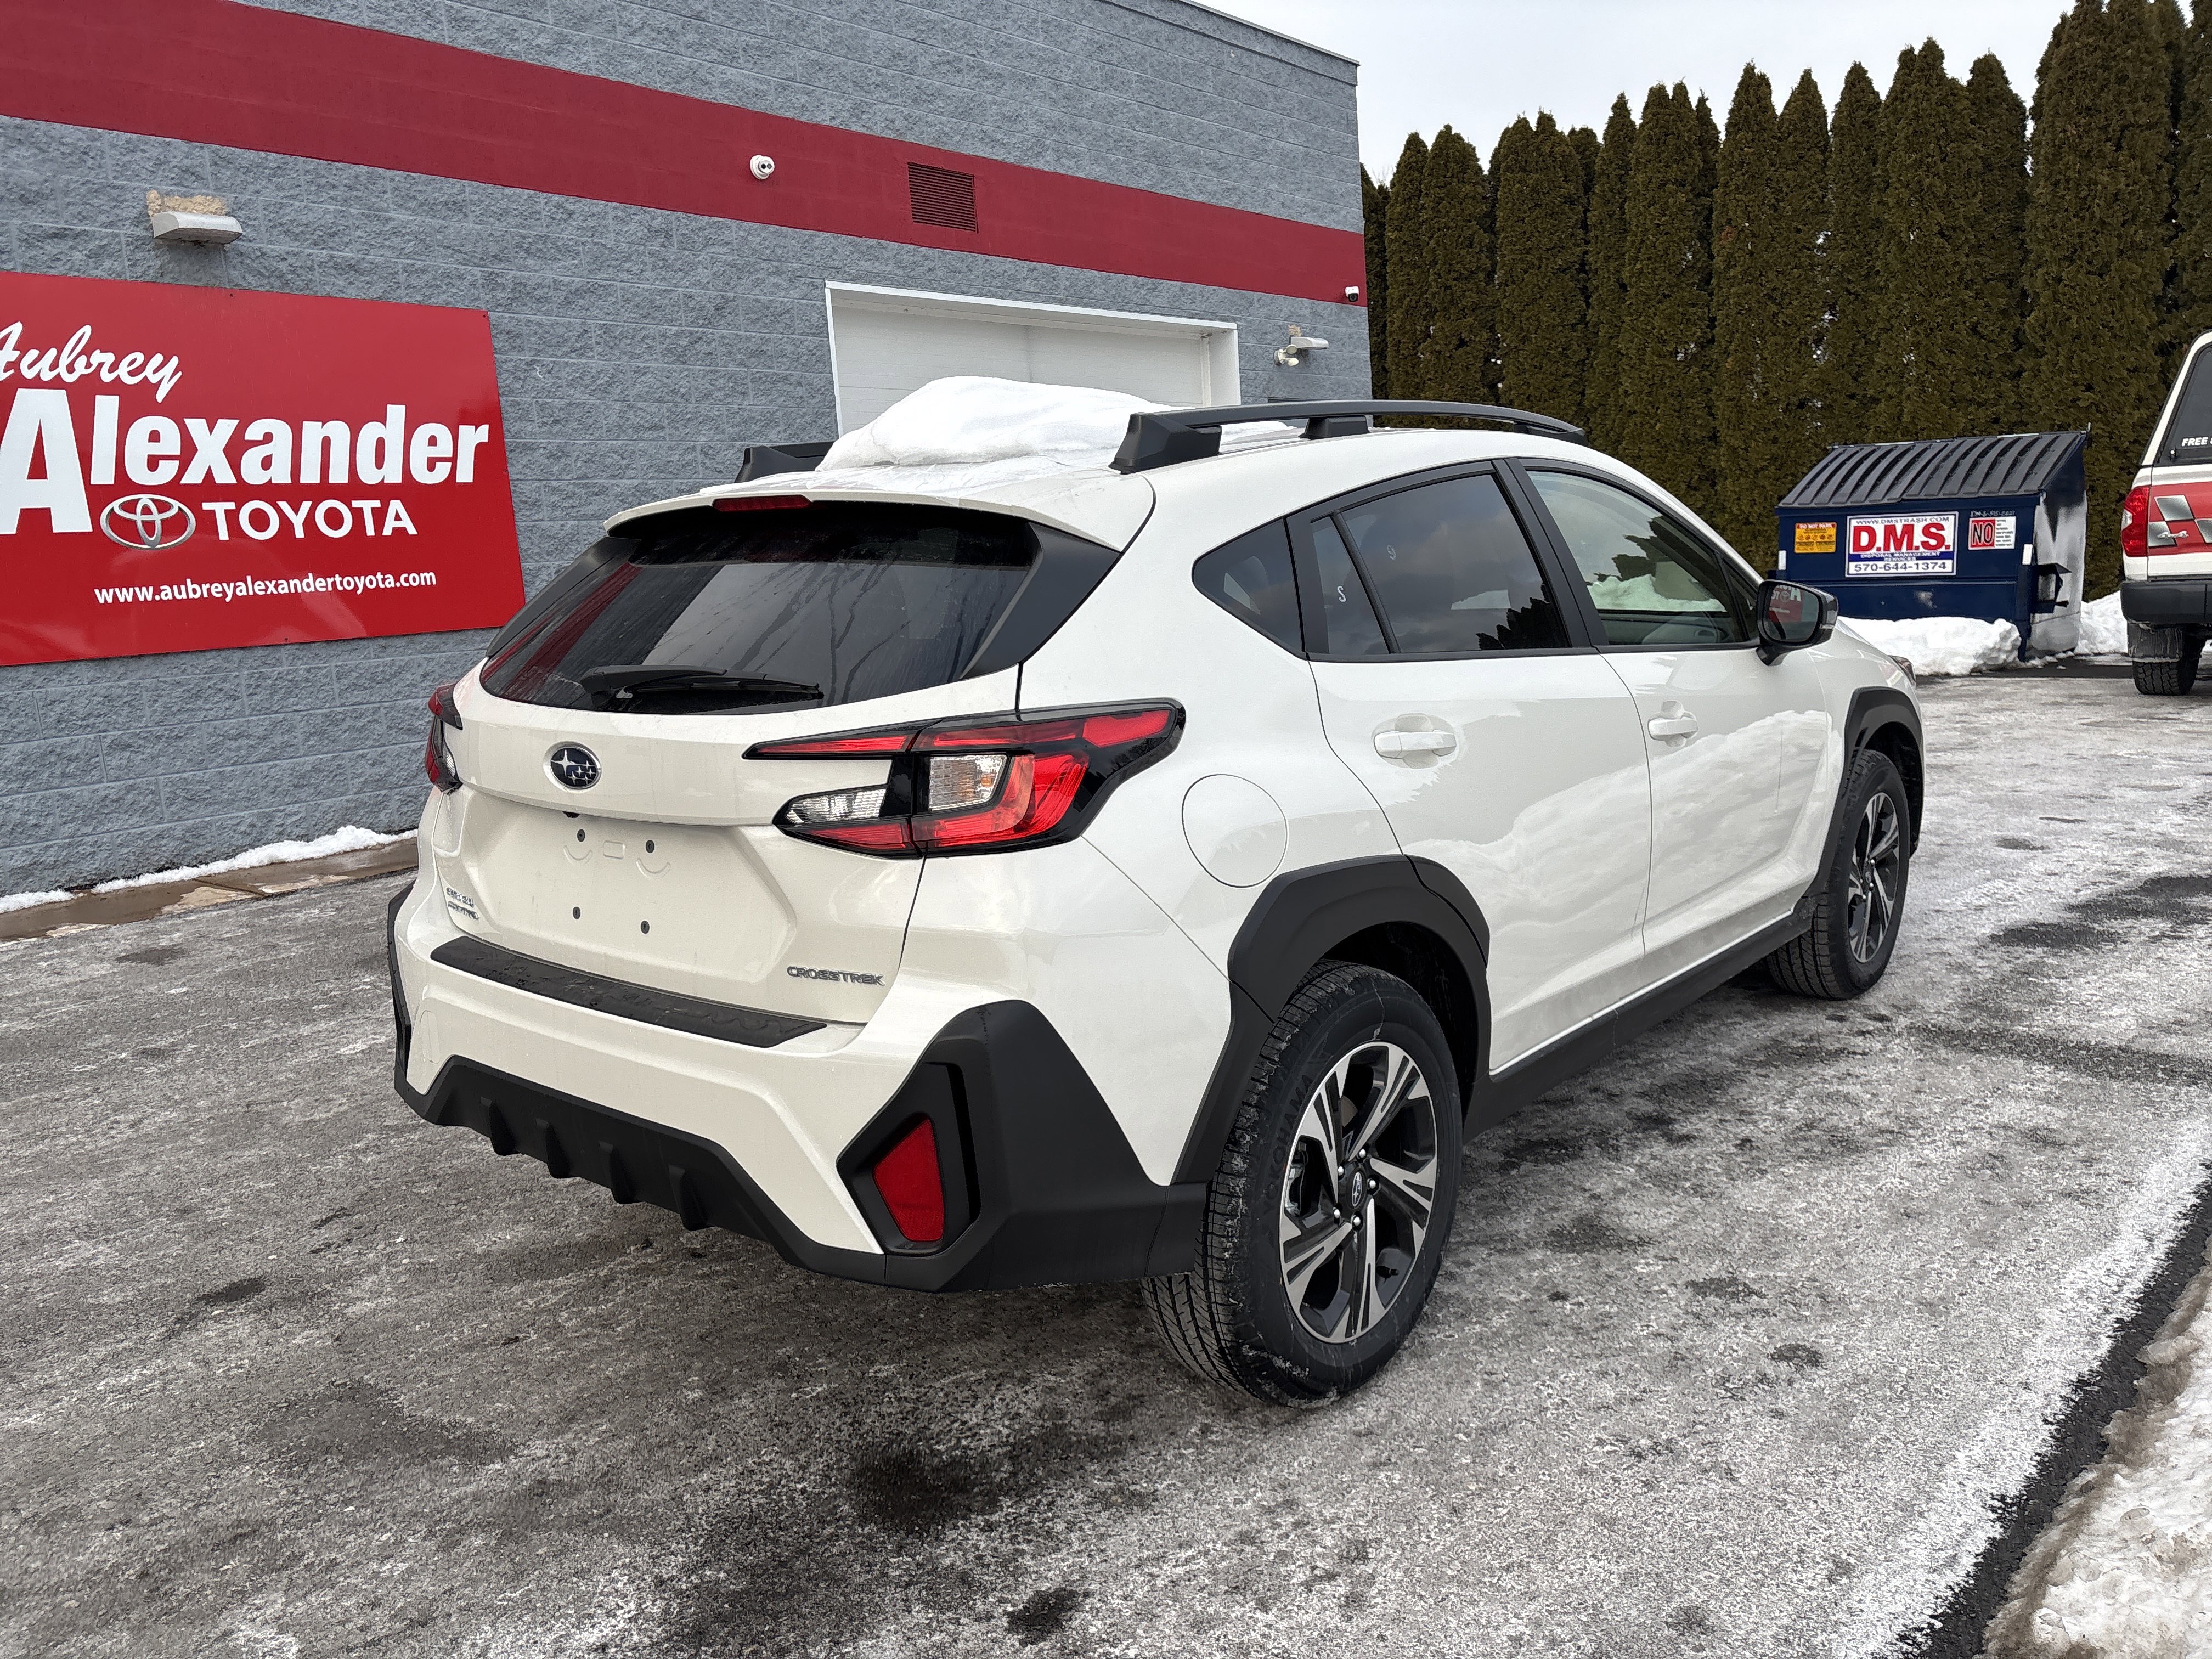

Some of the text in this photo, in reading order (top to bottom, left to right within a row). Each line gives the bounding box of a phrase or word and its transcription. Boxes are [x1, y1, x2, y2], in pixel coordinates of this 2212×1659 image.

[2181, 437, 2209, 447] FREE
[0, 388, 489, 535] Alexander
[201, 499, 418, 541] TOYOTA
[1972, 521, 1995, 545] NO
[1853, 523, 1951, 552] D.M.S.
[1854, 562, 1947, 572] 570-644-1374
[94, 569, 437, 604] www.aubreyalexandertoyota.com
[787, 966, 885, 986] CROSSTREK
